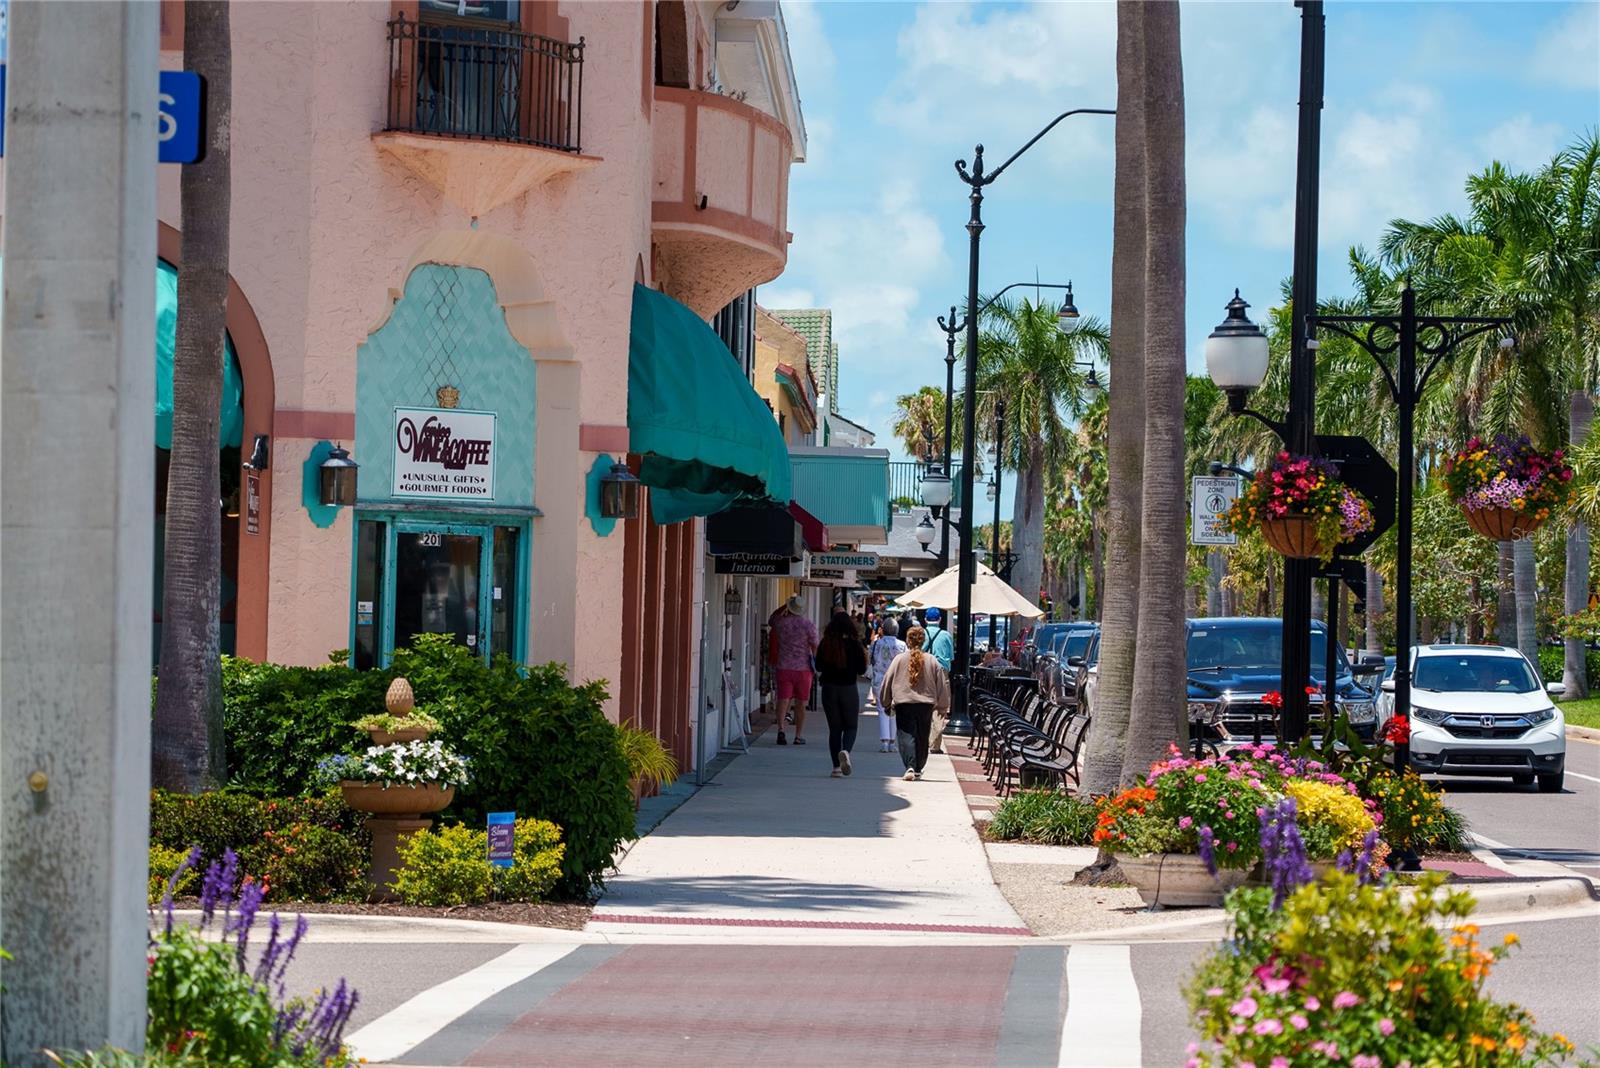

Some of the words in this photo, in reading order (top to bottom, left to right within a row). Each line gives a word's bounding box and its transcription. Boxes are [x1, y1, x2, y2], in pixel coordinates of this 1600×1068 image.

[408, 473, 450, 483] UNUSUAL
[453, 474, 480, 484] GIFTS
[405, 483, 449, 493] GOURMET
[452, 485, 482, 494] FOODS
[424, 534, 441, 546] 201
[820, 555, 875, 566] STATIONERS
[731, 562, 776, 573] Interiors
